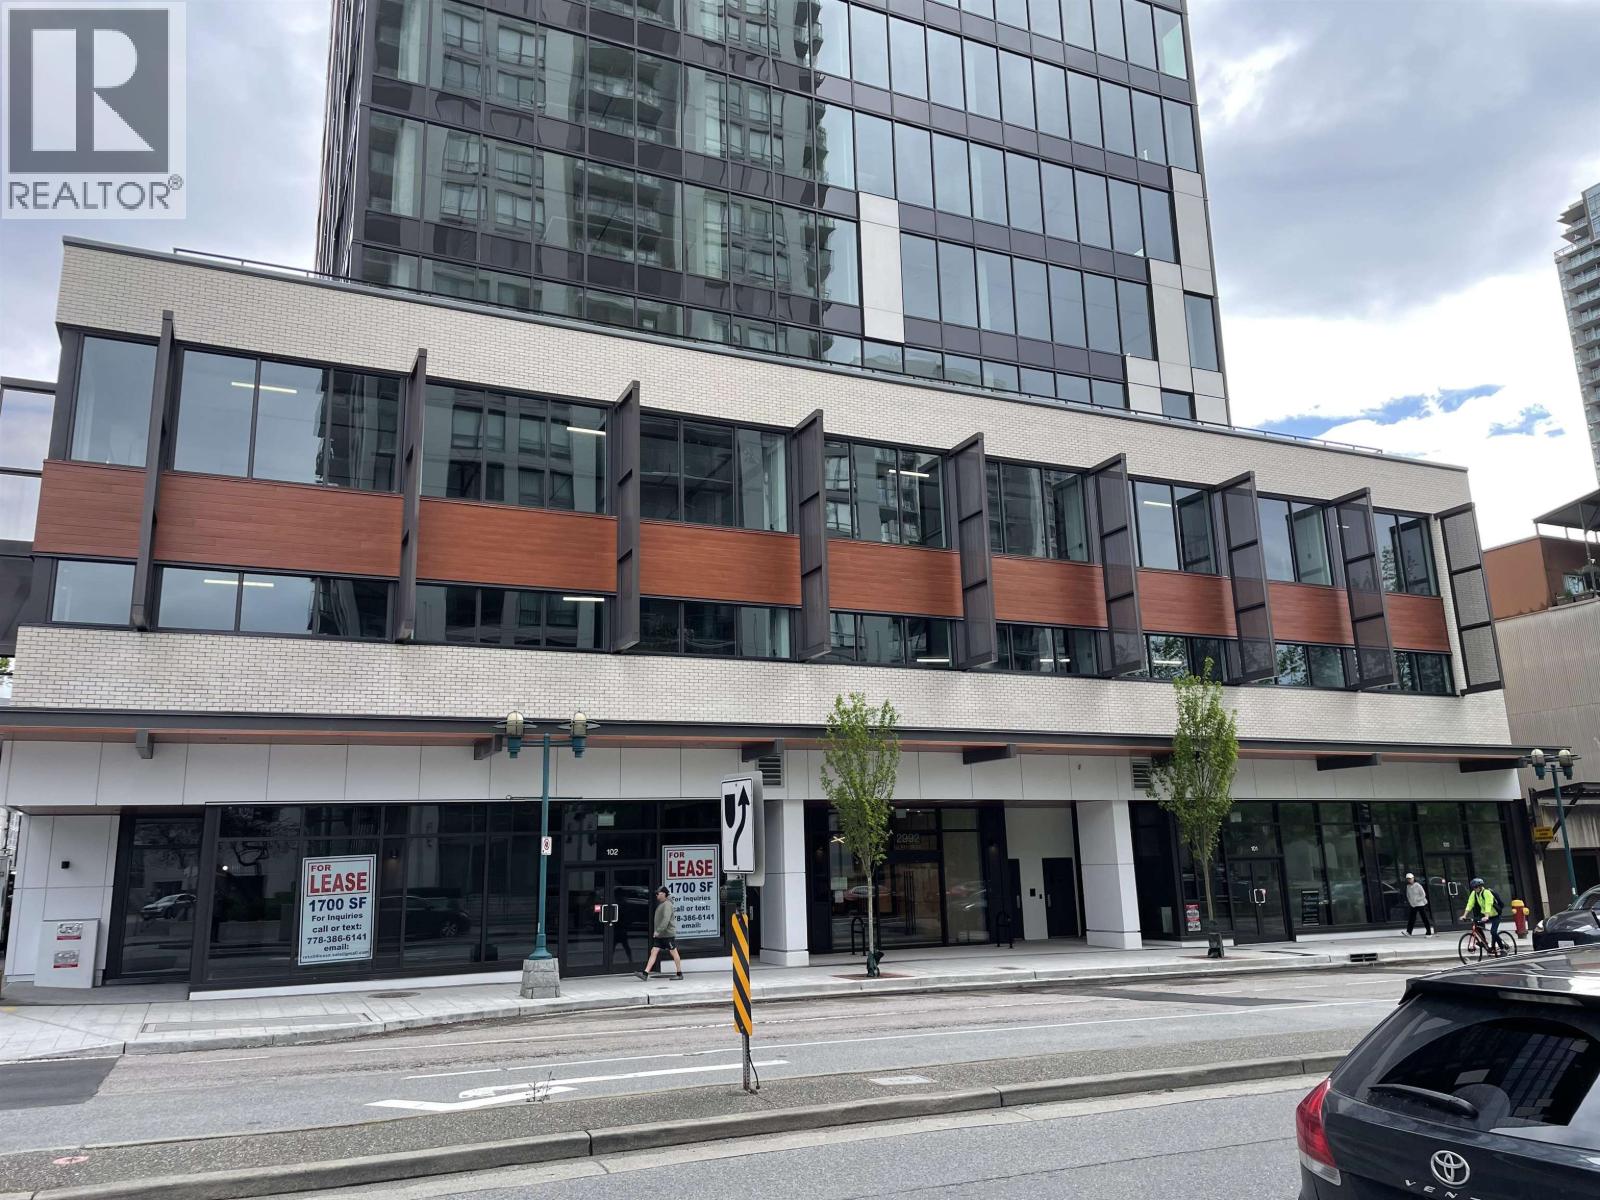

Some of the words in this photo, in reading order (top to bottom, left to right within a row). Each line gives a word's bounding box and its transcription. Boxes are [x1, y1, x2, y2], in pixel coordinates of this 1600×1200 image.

[896, 833, 921, 843] 2992
[606, 848, 619, 856] 102
[311, 864, 332, 872] FOR
[668, 859, 713, 877] LEASE
[309, 871, 368, 894] LEASE
[669, 881, 696, 894] 1700
[699, 881, 713, 893] SF
[308, 898, 344, 912] 1700
[348, 896, 367, 910] SF
[327, 912, 364, 922] Inquiries
[674, 914, 715, 922] 8-386-6141
[312, 925, 329, 933] call
[342, 923, 362, 931] text:
[307, 933, 367, 945] 778-386-6141
[323, 944, 350, 952] email:
